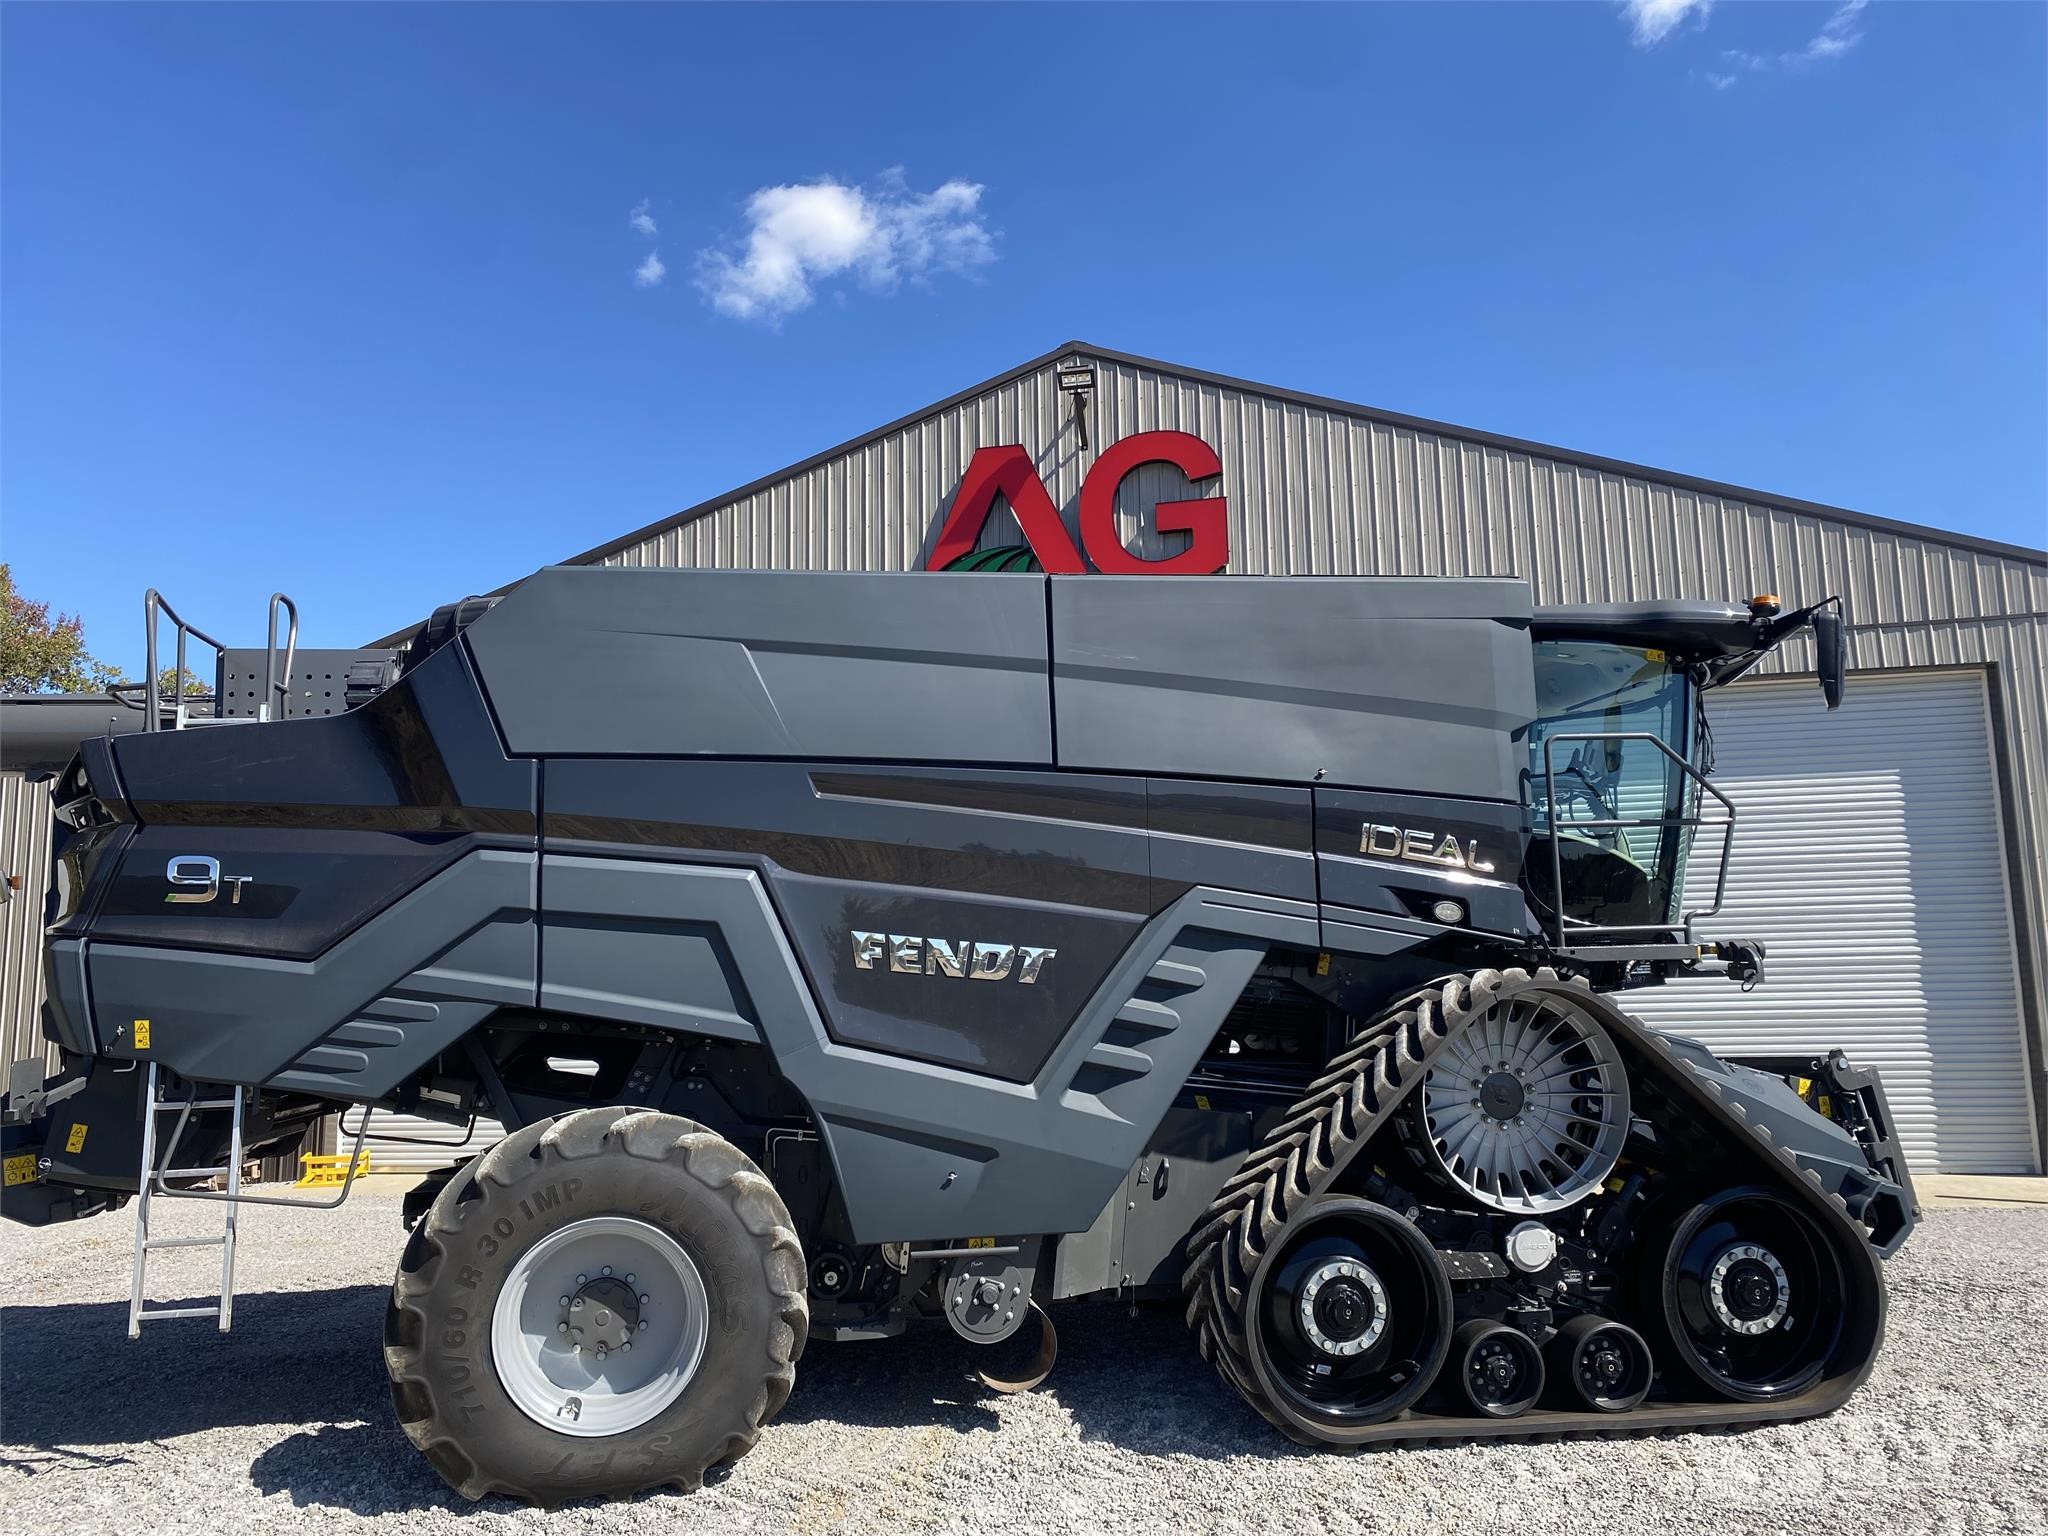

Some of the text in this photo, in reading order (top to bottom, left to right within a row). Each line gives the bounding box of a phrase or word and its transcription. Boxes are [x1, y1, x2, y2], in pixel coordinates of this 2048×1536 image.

[1359, 822, 1495, 873] IDEAL
[851, 930, 1058, 984] FENDT
[438, 1176, 586, 1425] 710/60 R 30 IMP
